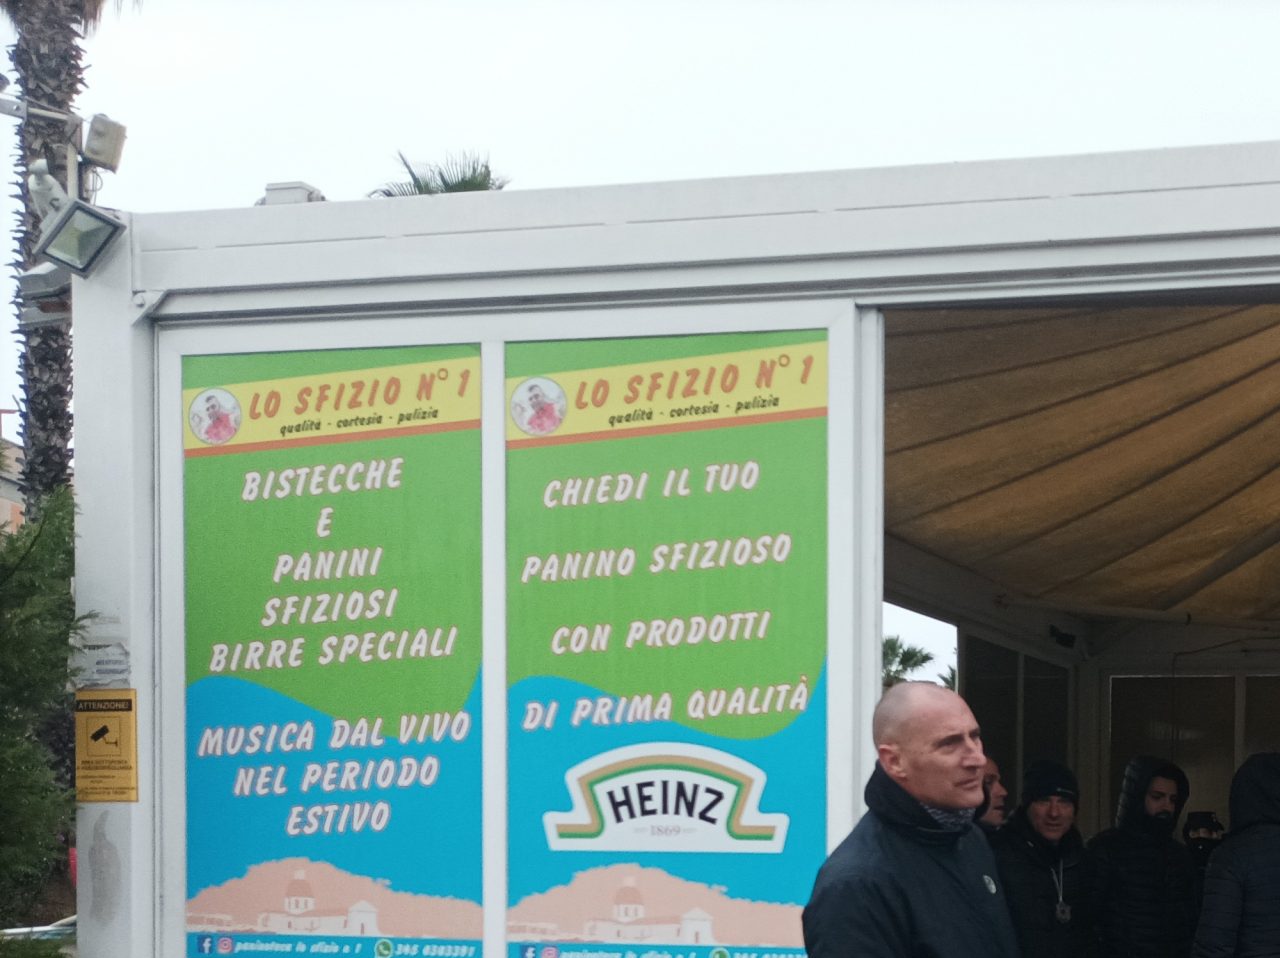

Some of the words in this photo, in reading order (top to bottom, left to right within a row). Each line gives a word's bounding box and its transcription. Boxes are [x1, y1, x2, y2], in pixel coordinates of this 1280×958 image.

[249, 390, 281, 420] LO
[294, 376, 401, 416] SFIZIO
[457, 368, 471, 398] 1
[575, 379, 610, 410] LO
[623, 363, 740, 405] SFIZIO
[800, 355, 814, 385] 1
[241, 457, 404, 502] BISTECCHE
[543, 471, 649, 509] CHIEDI
[662, 467, 691, 498] IL
[705, 460, 760, 493] TUO
[316, 507, 333, 538] E
[273, 546, 383, 584] PANINI
[520, 547, 637, 584] PANINO
[649, 533, 793, 574] SFIZIOSO
[260, 587, 399, 628] SFIZIOSI
[209, 637, 306, 674] BIRRE
[317, 625, 458, 667] SPECIALI
[551, 623, 611, 656] CON
[625, 610, 771, 649] PRODOTTI
[521, 701, 560, 732] DI
[570, 692, 673, 727] PRIMA
[686, 674, 809, 720] QUALITÀ
[197, 720, 316, 758] MUSICA
[329, 716, 385, 749] DAL
[399, 710, 472, 745] VIVO
[232, 765, 289, 797] NEL
[301, 755, 441, 793] PERIODO
[285, 800, 393, 837] ESTIVO
[606, 780, 725, 825] HEINZ
[650, 823, 681, 836] 1869
